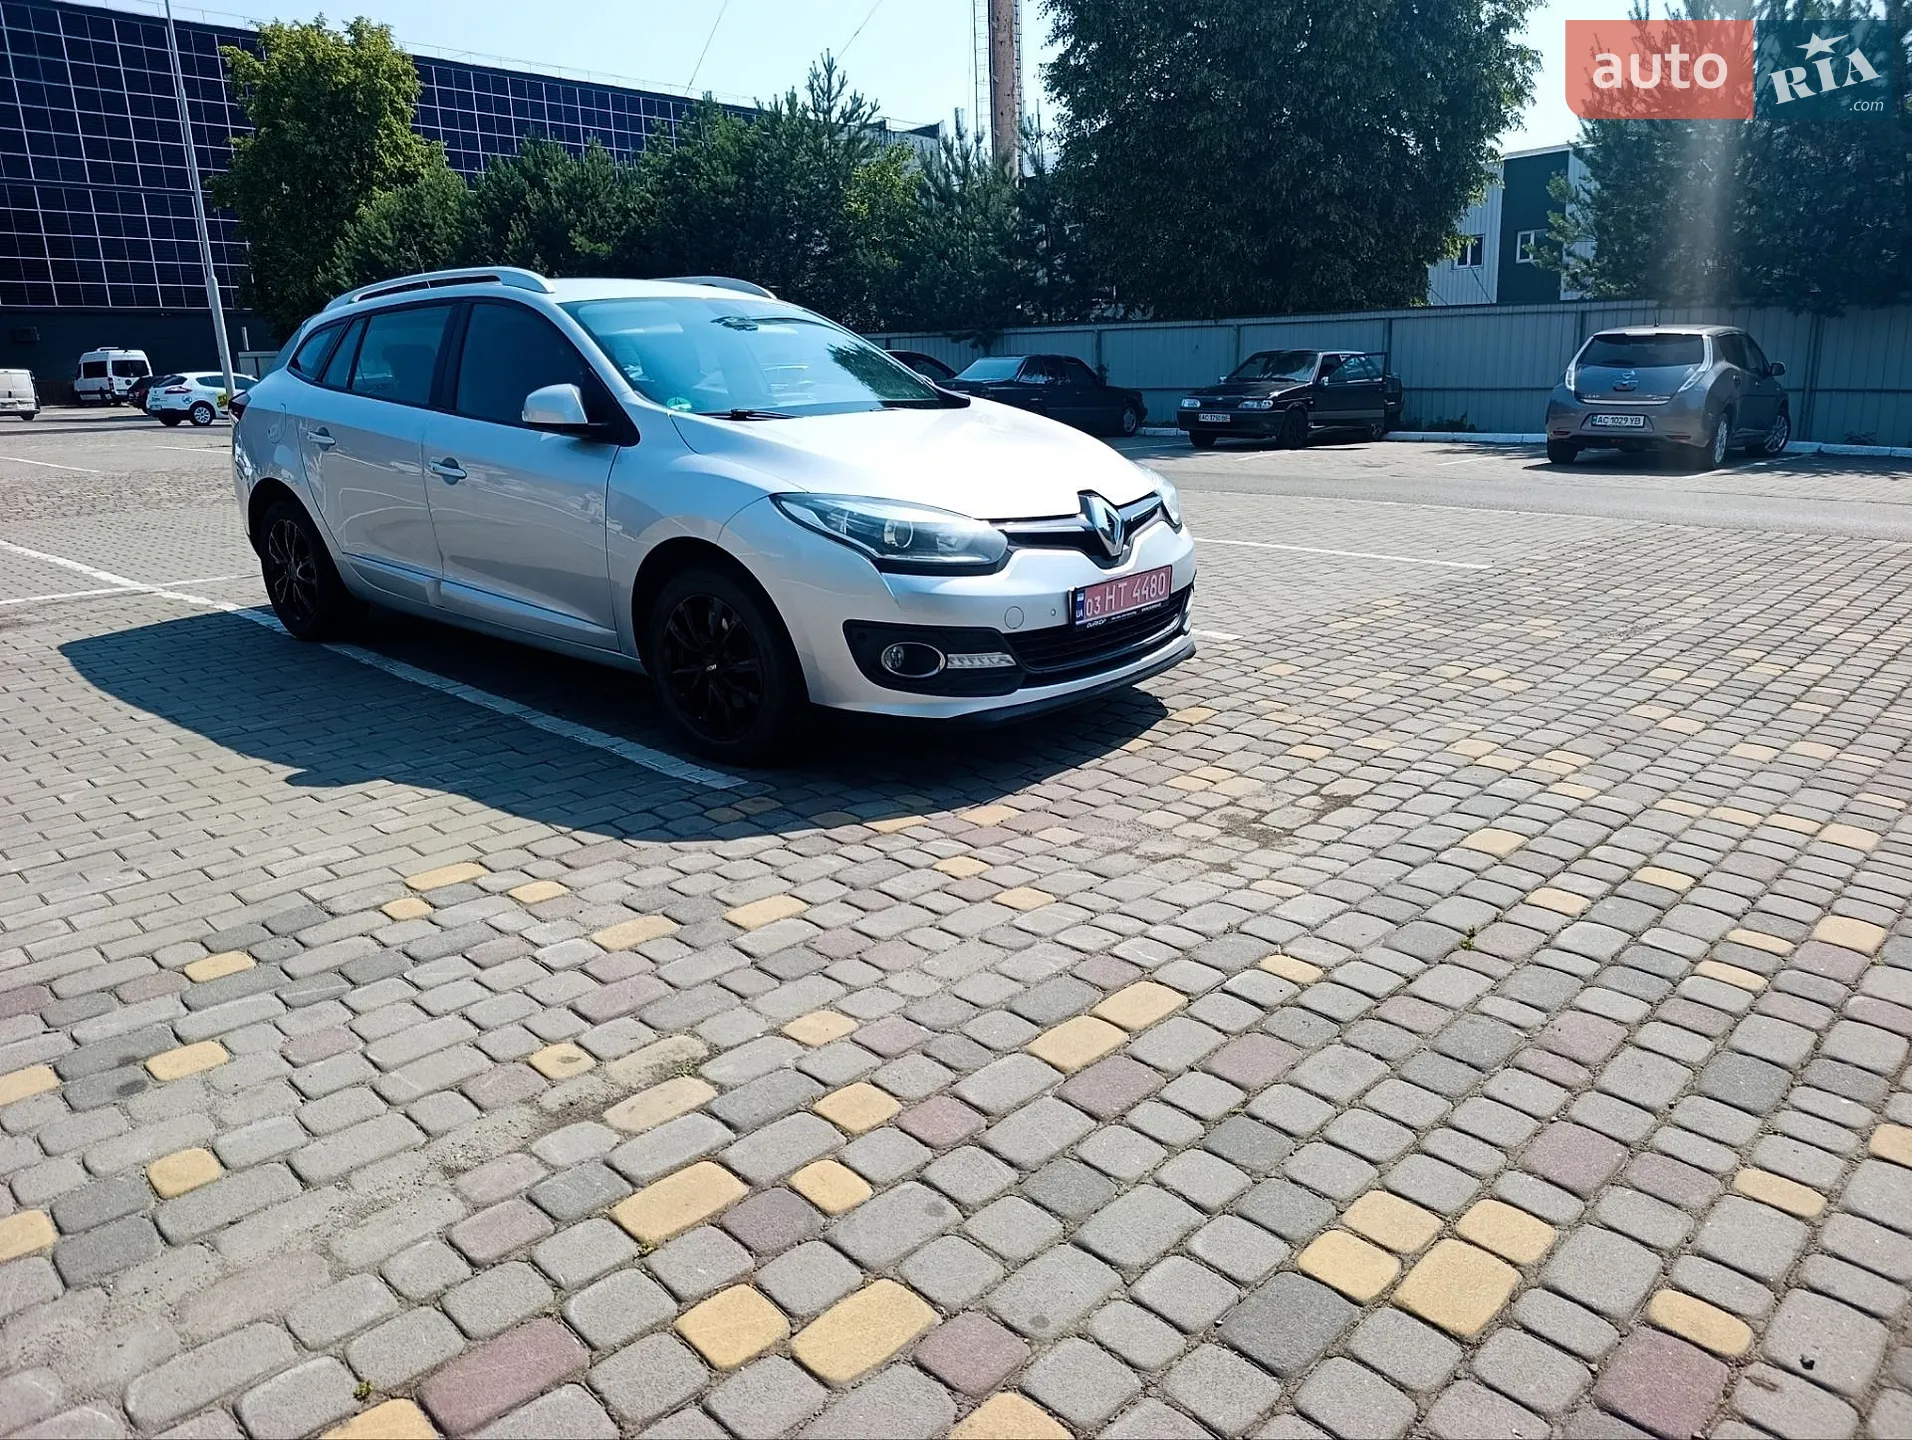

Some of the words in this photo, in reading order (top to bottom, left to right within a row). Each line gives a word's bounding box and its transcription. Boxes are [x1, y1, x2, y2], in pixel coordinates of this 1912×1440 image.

[1597, 416, 1608, 424] AC
[1610, 416, 1628, 424] 1029
[1086, 595, 1101, 616] 03
[1105, 582, 1127, 611] HT
[1132, 572, 1166, 602] 4480
[1076, 608, 1083, 618] UA
